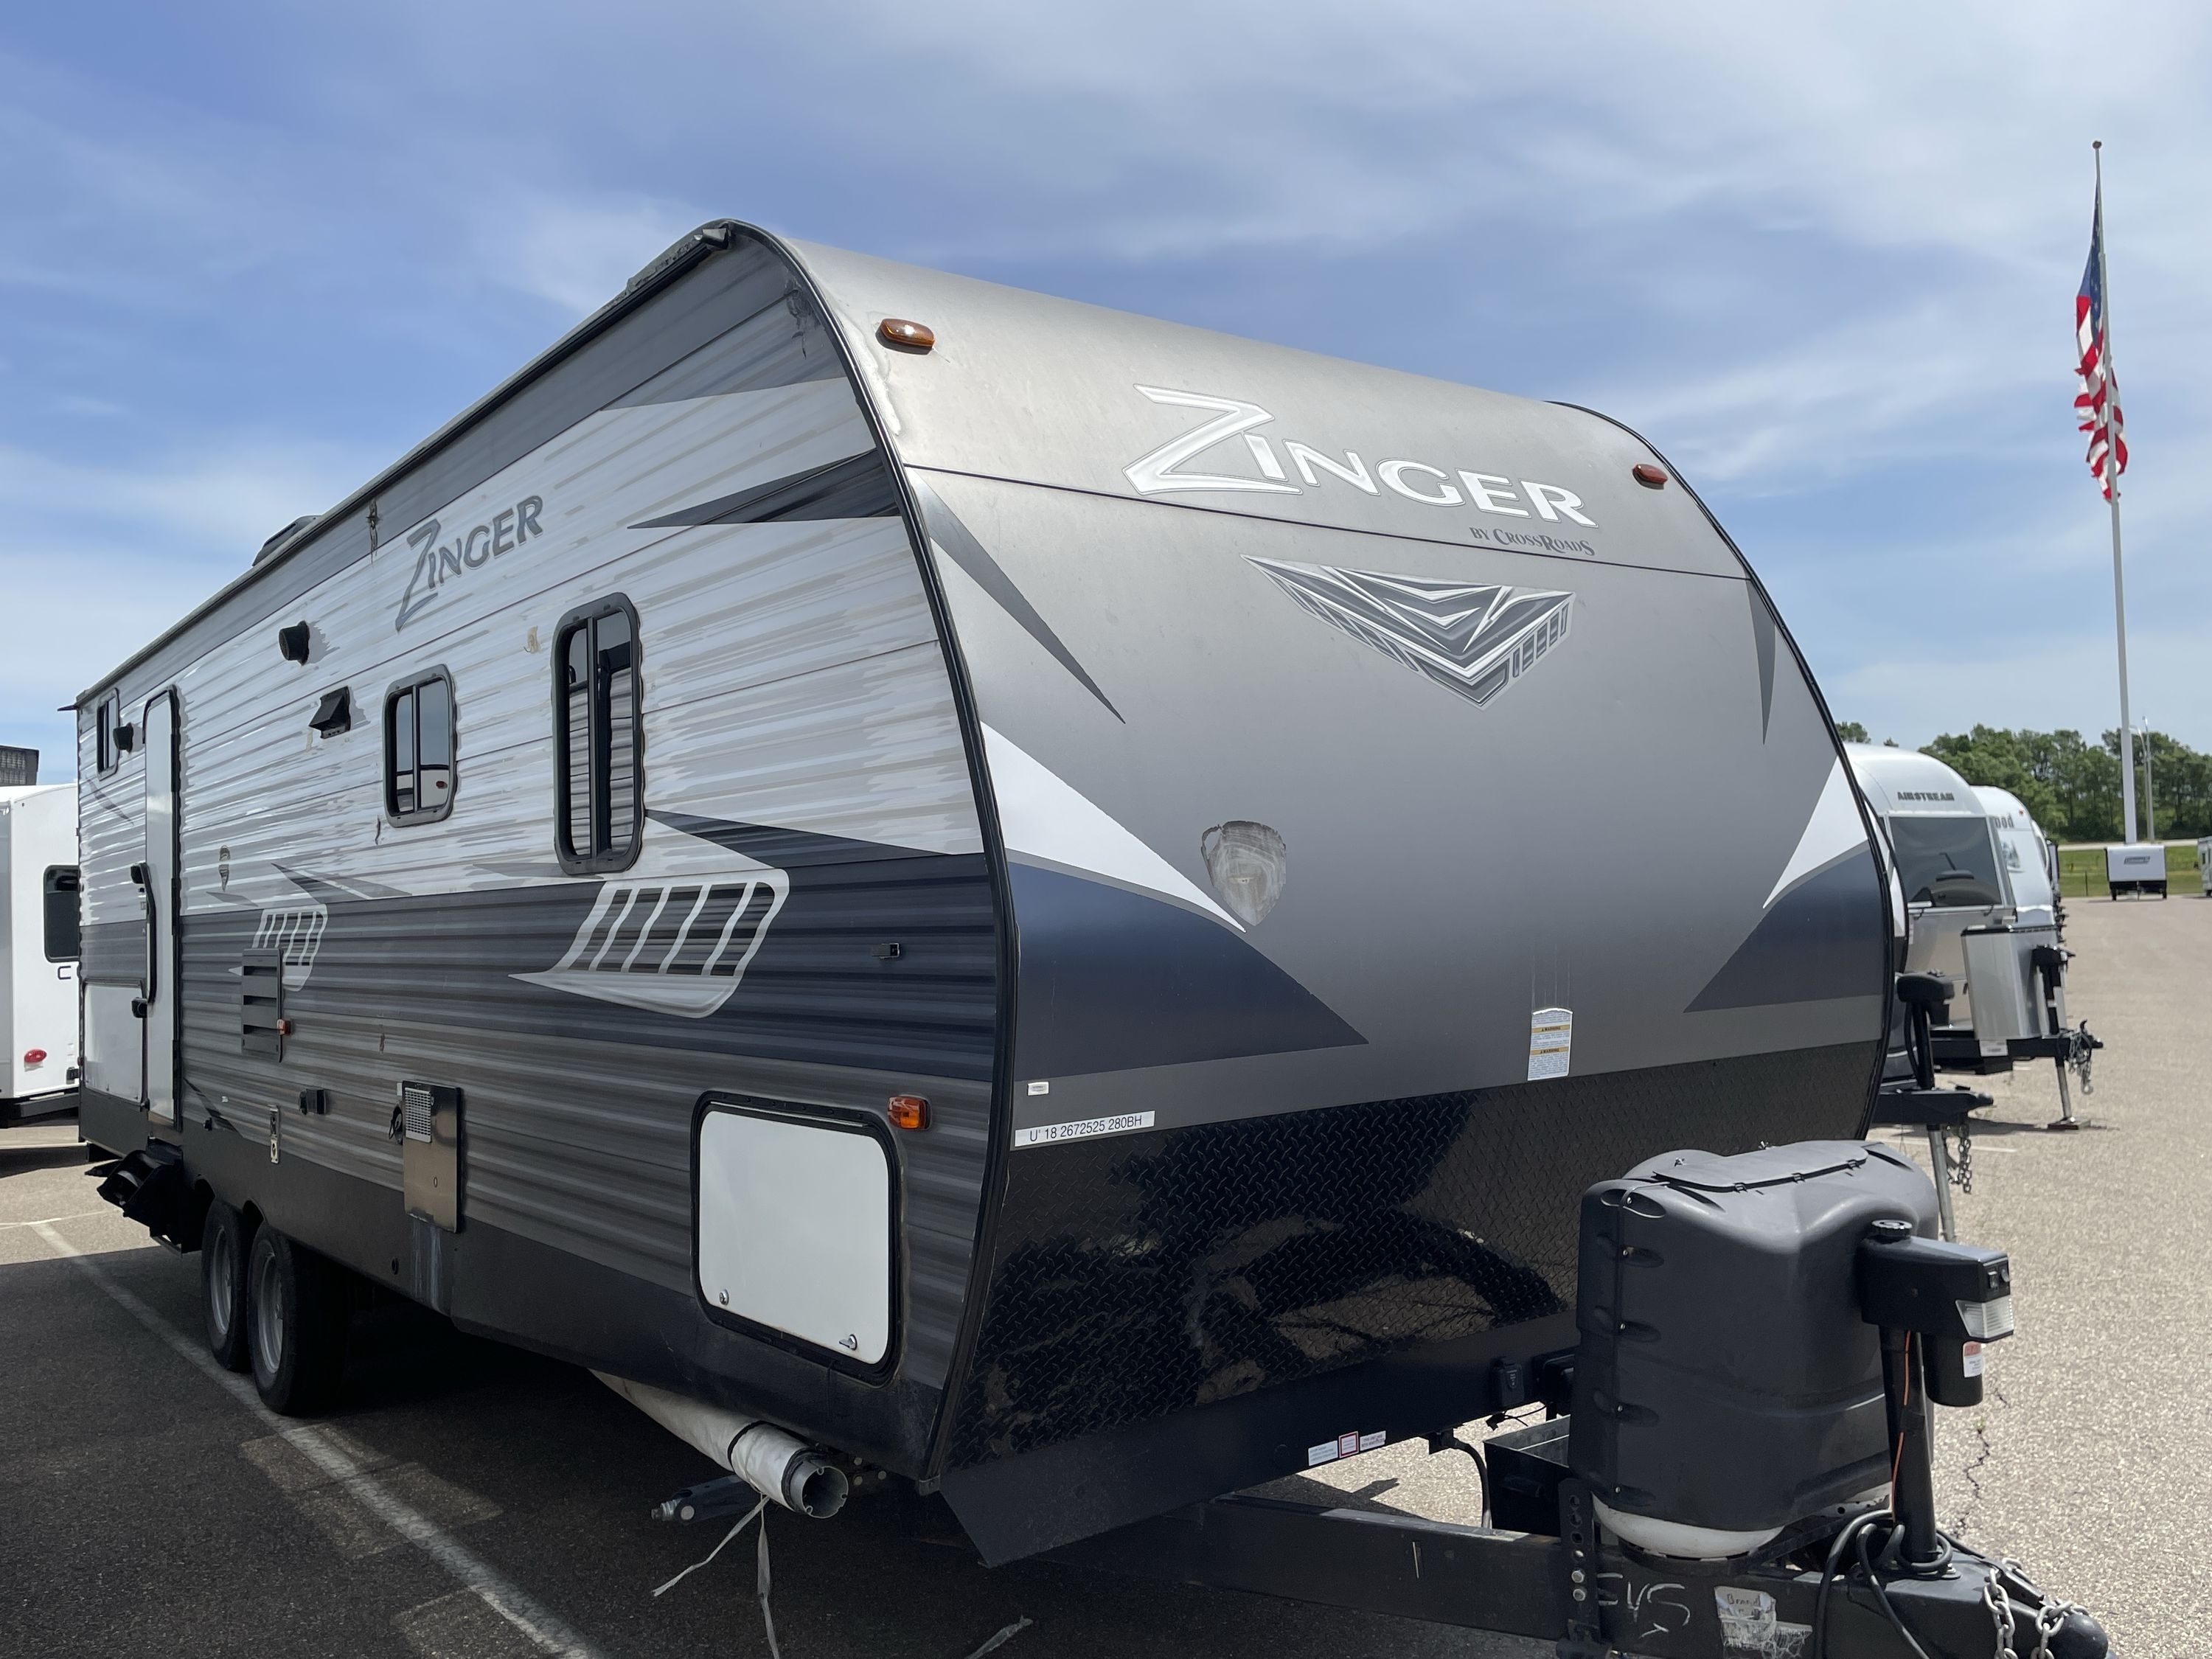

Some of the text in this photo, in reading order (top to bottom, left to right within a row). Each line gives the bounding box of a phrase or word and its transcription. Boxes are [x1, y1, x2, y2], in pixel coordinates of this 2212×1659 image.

[1121, 383, 1599, 529] ZINGER
[1469, 526, 1490, 540] BY
[395, 495, 544, 633] ZINGER
[1897, 791, 1955, 801] AIRSTREAM
[1045, 1127, 1057, 1140] 18
[1060, 1120, 1105, 1138] 2672525
[1108, 1114, 1142, 1130] 280BH
